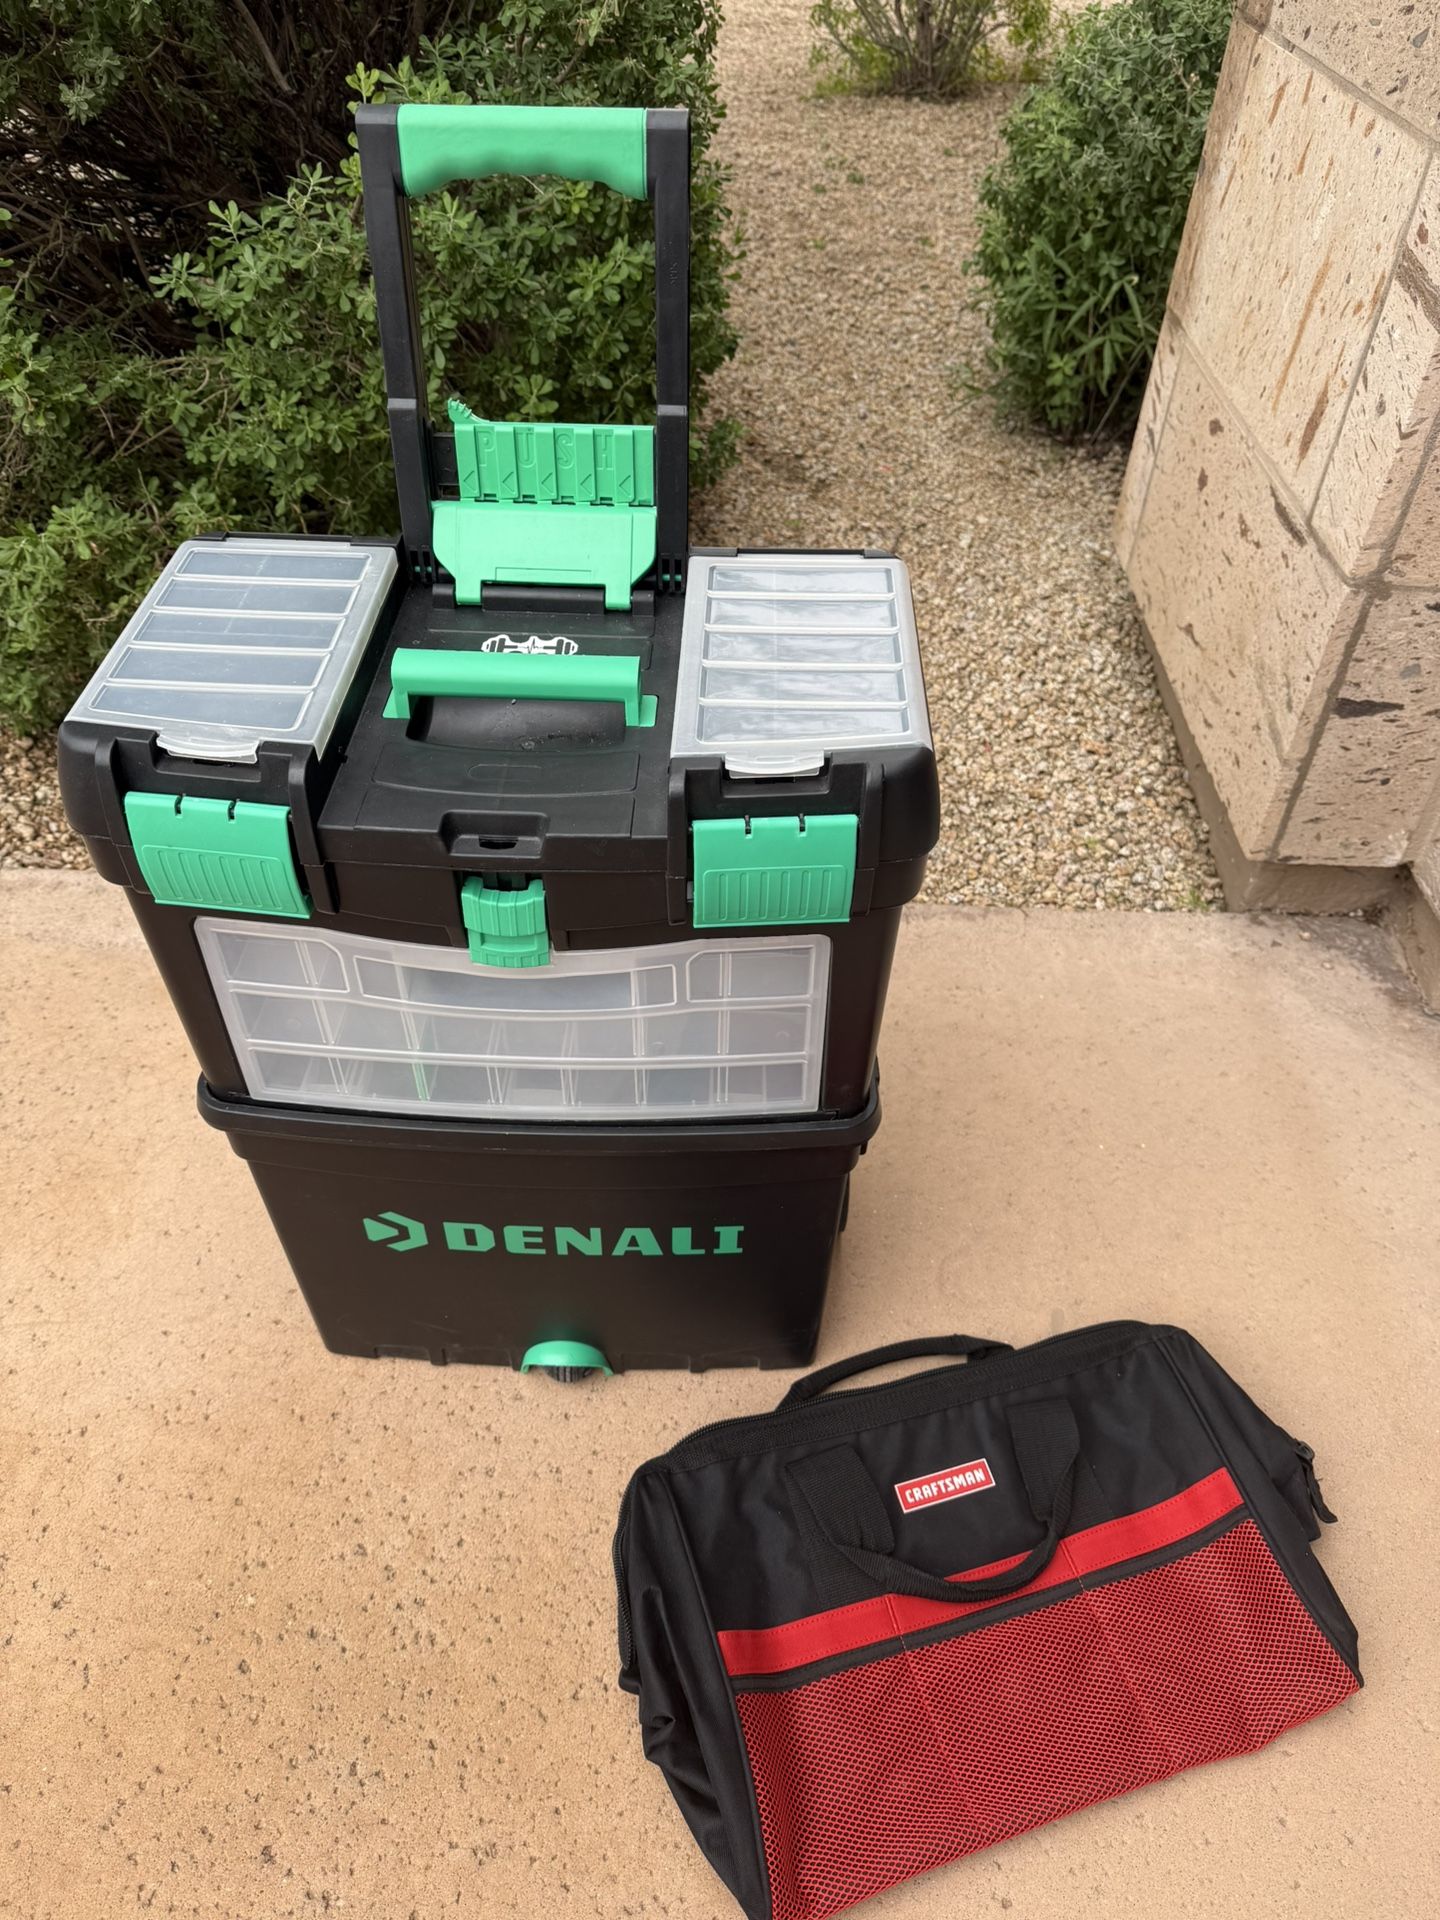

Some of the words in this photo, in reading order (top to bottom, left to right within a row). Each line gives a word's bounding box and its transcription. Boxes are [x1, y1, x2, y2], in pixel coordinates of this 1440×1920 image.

[477, 429, 614, 471] PUSH
[443, 1221, 745, 1256] DENALI
[905, 1468, 986, 1503] CRAFTSMAN
